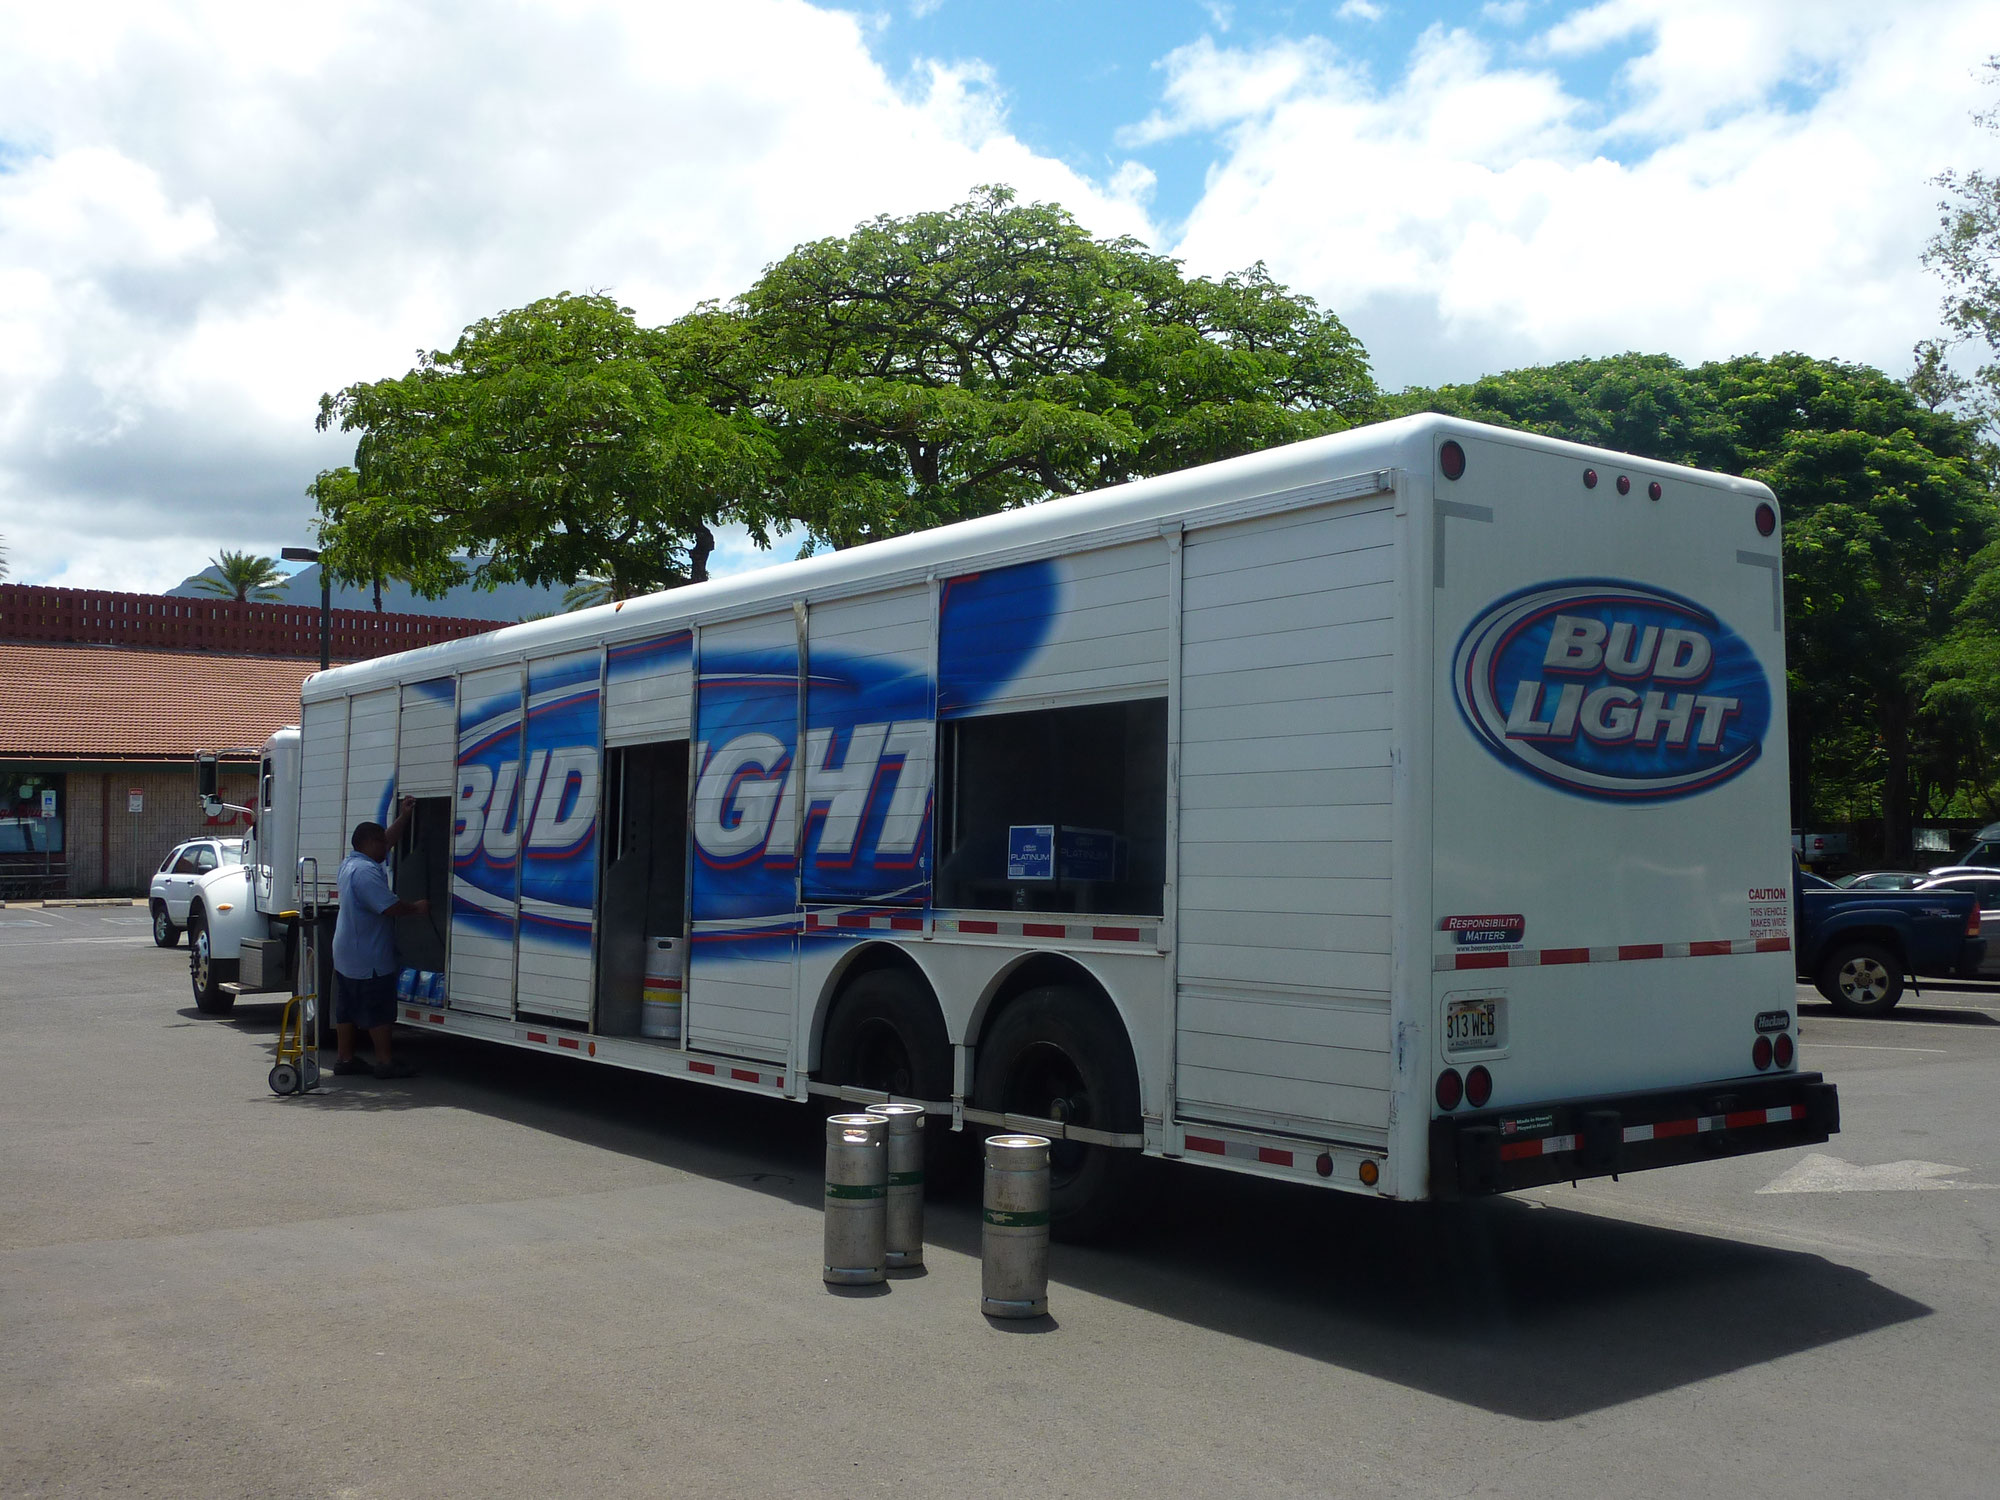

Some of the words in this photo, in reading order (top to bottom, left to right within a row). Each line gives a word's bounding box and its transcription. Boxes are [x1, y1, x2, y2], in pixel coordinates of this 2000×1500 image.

[1543, 614, 1713, 683] BUD
[1504, 679, 1740, 748] LIGHT
[453, 745, 598, 866] BUD
[1010, 853, 1050, 861] PLATINUM
[1748, 888, 1786, 900] CAUTION
[1749, 907, 1763, 917] THIS
[1763, 906, 1788, 916] VEHICLE
[1448, 917, 1520, 930] RESPONSIBILITY
[1750, 918, 1771, 928] MAKES
[1772, 917, 1787, 927] WIDE
[1465, 930, 1507, 942] MATTERS
[1749, 929, 1768, 939] RIGHT
[1769, 928, 1788, 938] TURNS
[1447, 1014, 1469, 1039] 313
[1471, 1012, 1495, 1037] WEB
